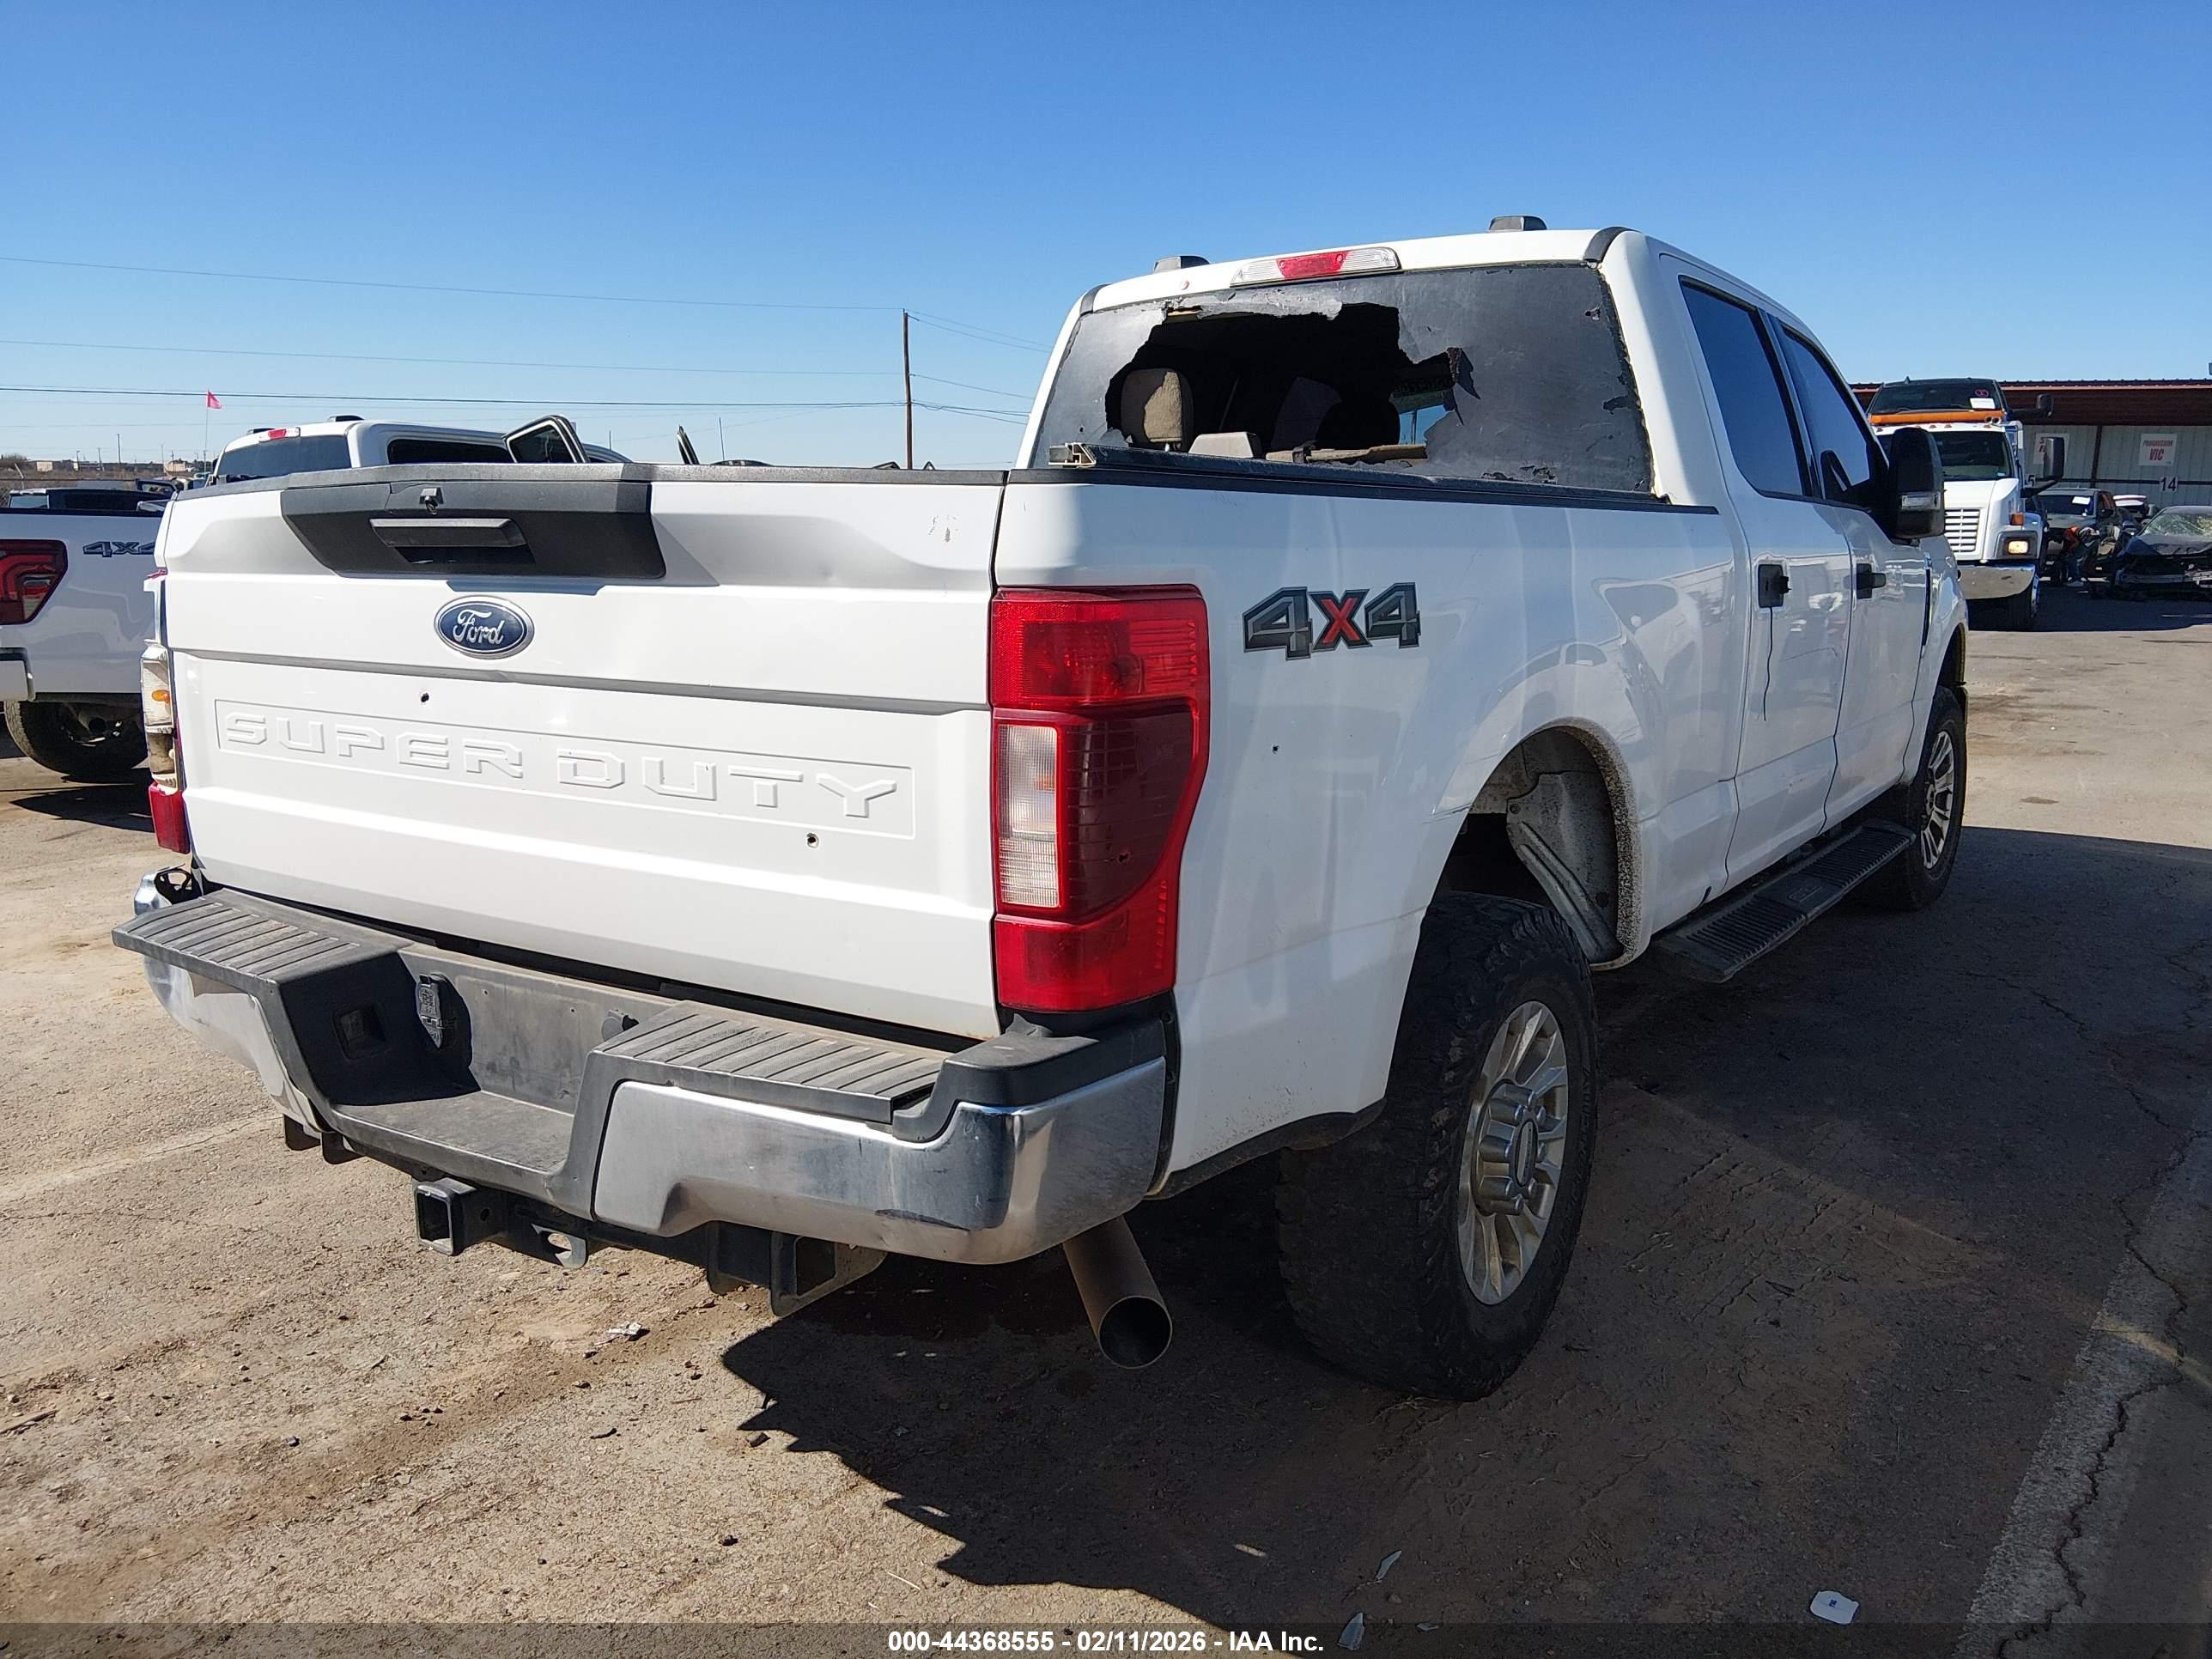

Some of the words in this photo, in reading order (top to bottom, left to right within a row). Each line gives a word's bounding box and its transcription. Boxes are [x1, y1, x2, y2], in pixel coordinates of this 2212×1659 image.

[2149, 447, 2165, 461] VIC
[2160, 477, 2177, 492] 14
[452, 608, 506, 645] Ford
[225, 711, 524, 780] SUPER
[556, 747, 897, 819] DUTY
